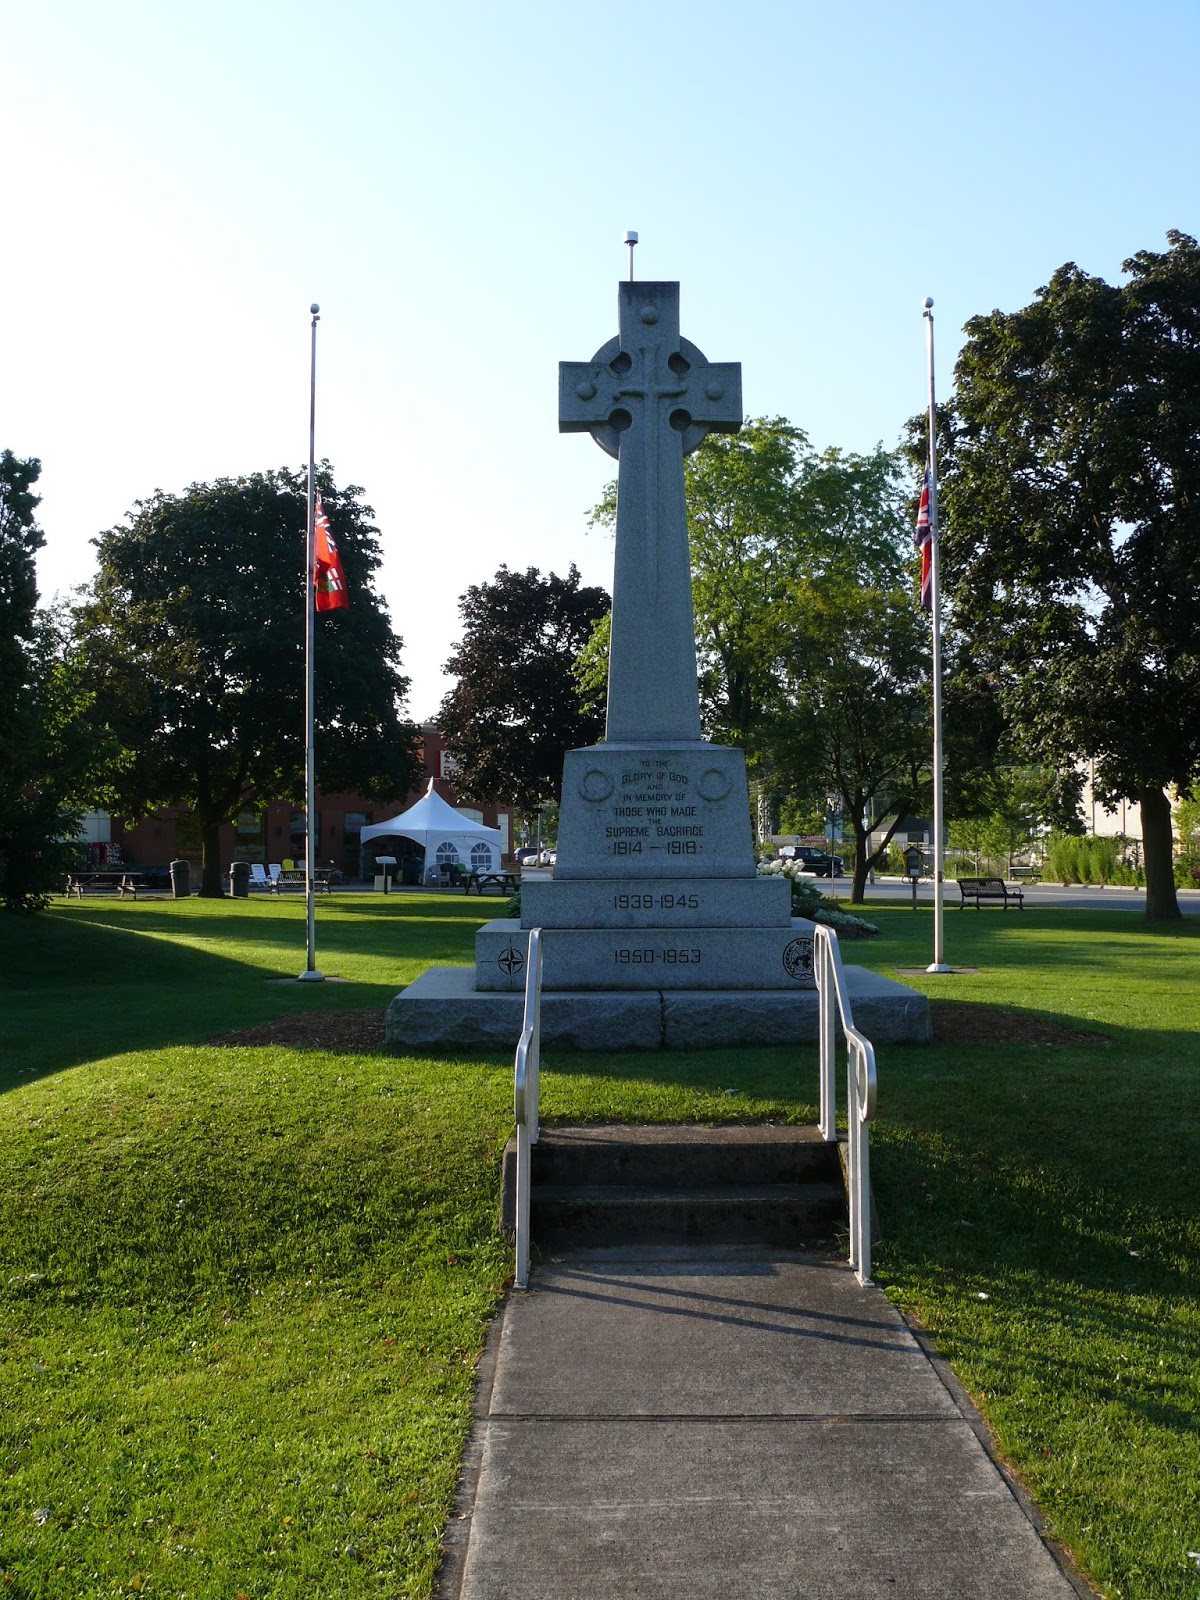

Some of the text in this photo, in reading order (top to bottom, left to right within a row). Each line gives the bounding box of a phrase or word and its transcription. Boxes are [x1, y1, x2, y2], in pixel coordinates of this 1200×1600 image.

[621, 772, 688, 785] GLORY OF GOD
[623, 793, 687, 802] IN MEMORY OF
[614, 806, 697, 817] THOSE WHO MADE
[606, 826, 704, 838] SUPREME SACRIFICE
[613, 841, 643, 855] 1914
[667, 841, 696, 855] 1918
